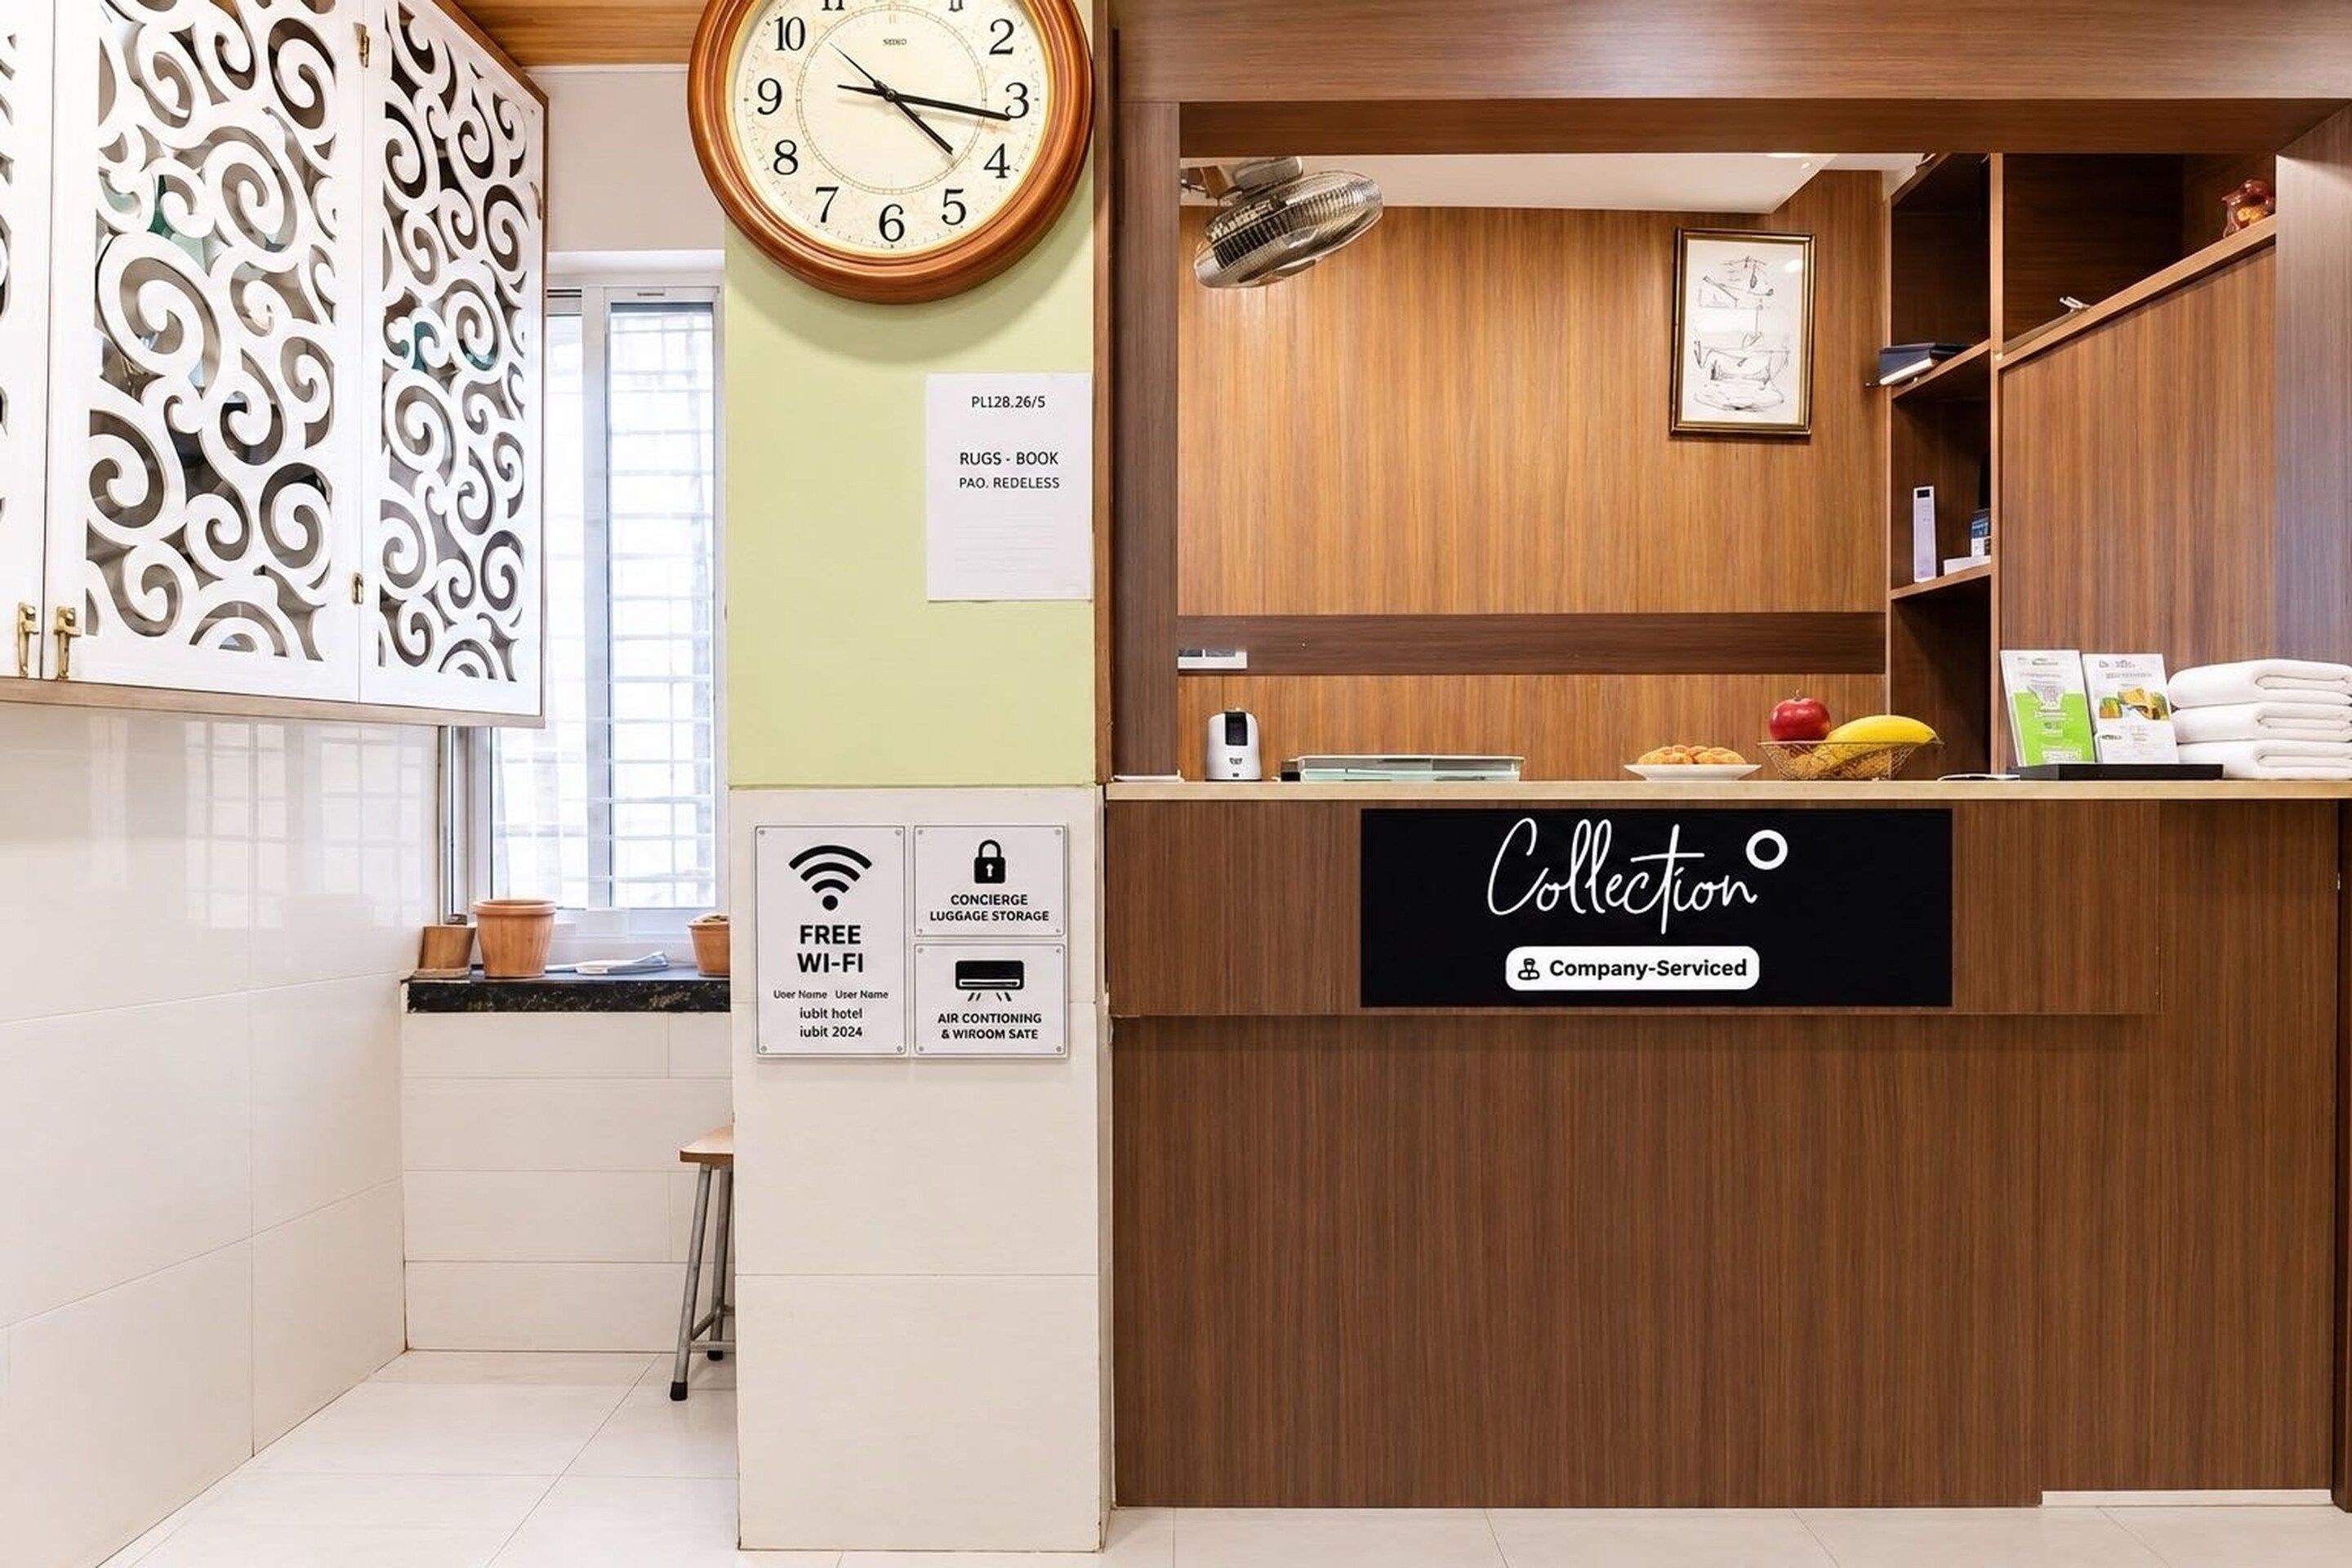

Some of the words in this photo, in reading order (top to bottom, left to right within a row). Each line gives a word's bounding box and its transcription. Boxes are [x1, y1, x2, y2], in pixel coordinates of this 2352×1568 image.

[774, 16, 806, 51] 10
[989, 18, 1014, 55] 2
[757, 78, 782, 115] 9
[1004, 82, 1030, 118] 3
[773, 140, 799, 176] 8
[983, 143, 1010, 179] 4
[815, 186, 840, 224] 7
[941, 188, 967, 226] 5
[879, 203, 905, 243] 6
[960, 452, 1002, 466] RUGS
[1016, 452, 1058, 466] BOOK
[993, 477, 1060, 489] REDELESS
[1487, 817, 1758, 935] Collection
[950, 893, 1028, 906] CONCIERGE
[929, 911, 988, 922] LUGGAGE
[991, 911, 1049, 922] STORAGE
[800, 924, 862, 945] FREE
[797, 952, 863, 973] WI-FI
[1549, 958, 1747, 982] Company-Serviced
[831, 1008, 862, 1019] hotel
[938, 1013, 959, 1024] AIR
[962, 1013, 1042, 1024] CONTIONING
[832, 1026, 862, 1038] 2024
[952, 1029, 1005, 1040] WIROOM
[1009, 1029, 1039, 1040] SATE
